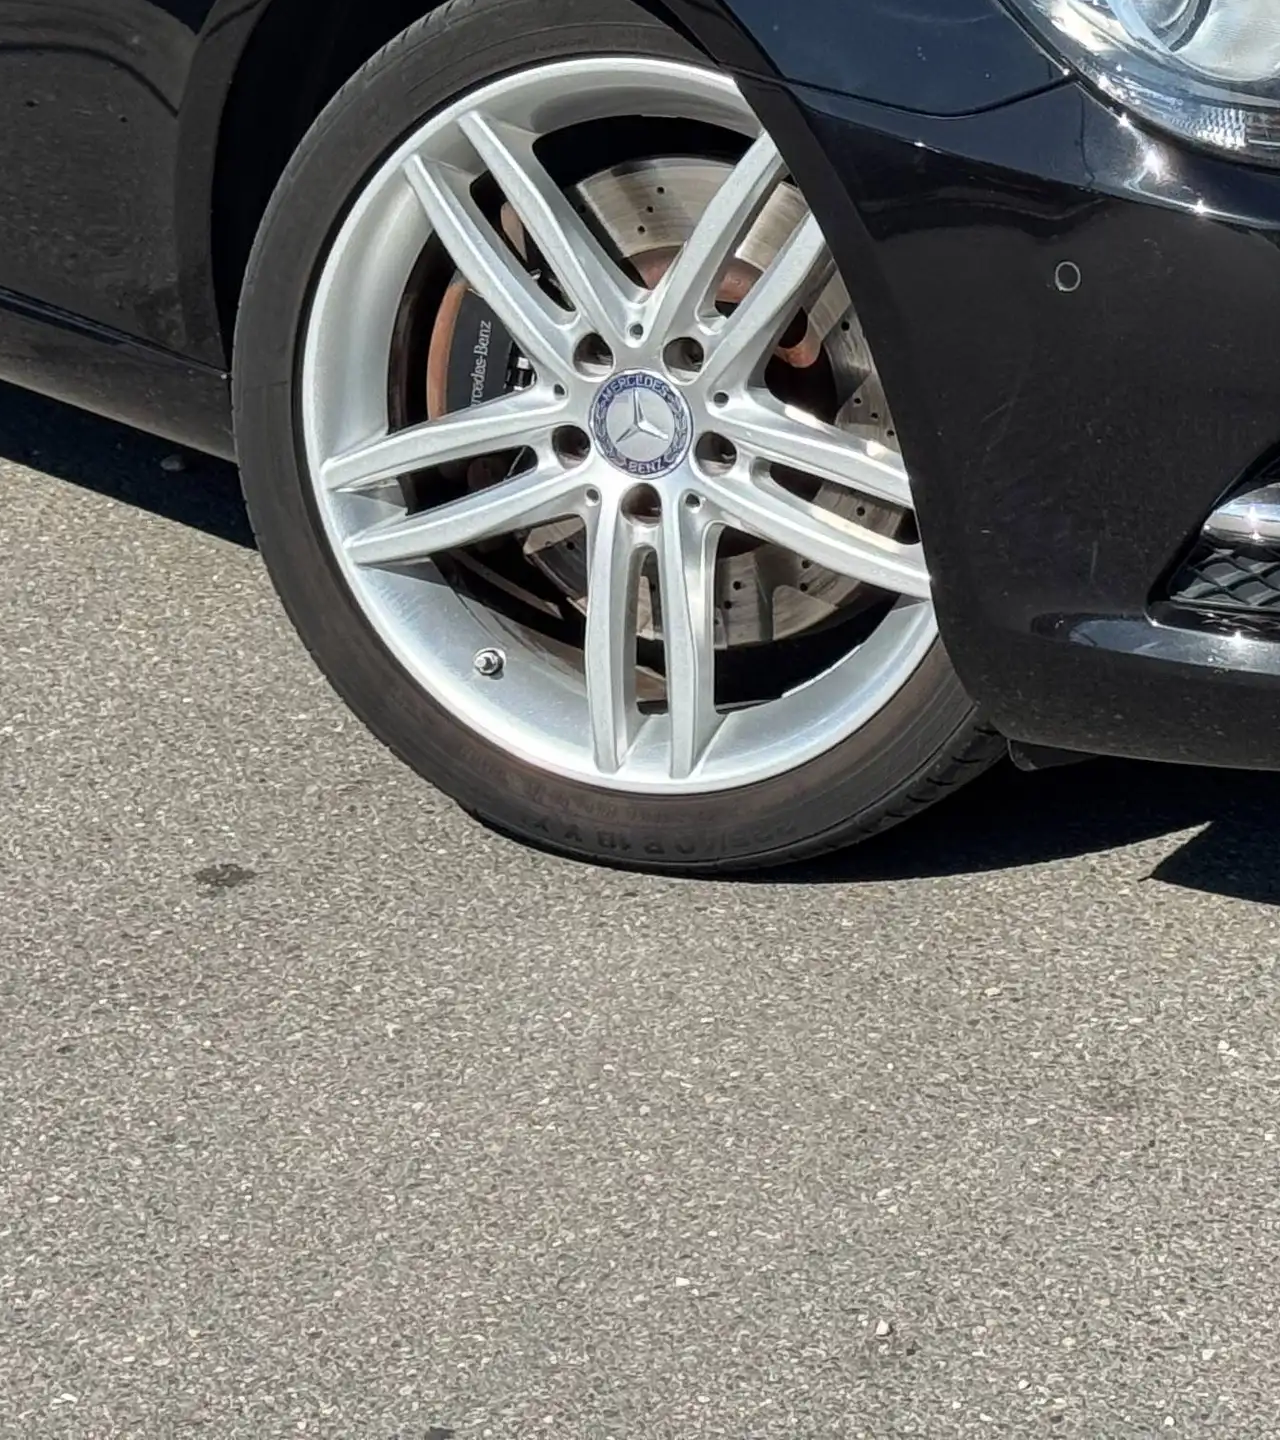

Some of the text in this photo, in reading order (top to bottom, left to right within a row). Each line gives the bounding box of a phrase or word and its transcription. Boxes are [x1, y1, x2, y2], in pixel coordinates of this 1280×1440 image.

[469, 320, 492, 404] rcedes-Benz
[601, 373, 670, 402] MERCEDES
[627, 458, 665, 474] BENZ
